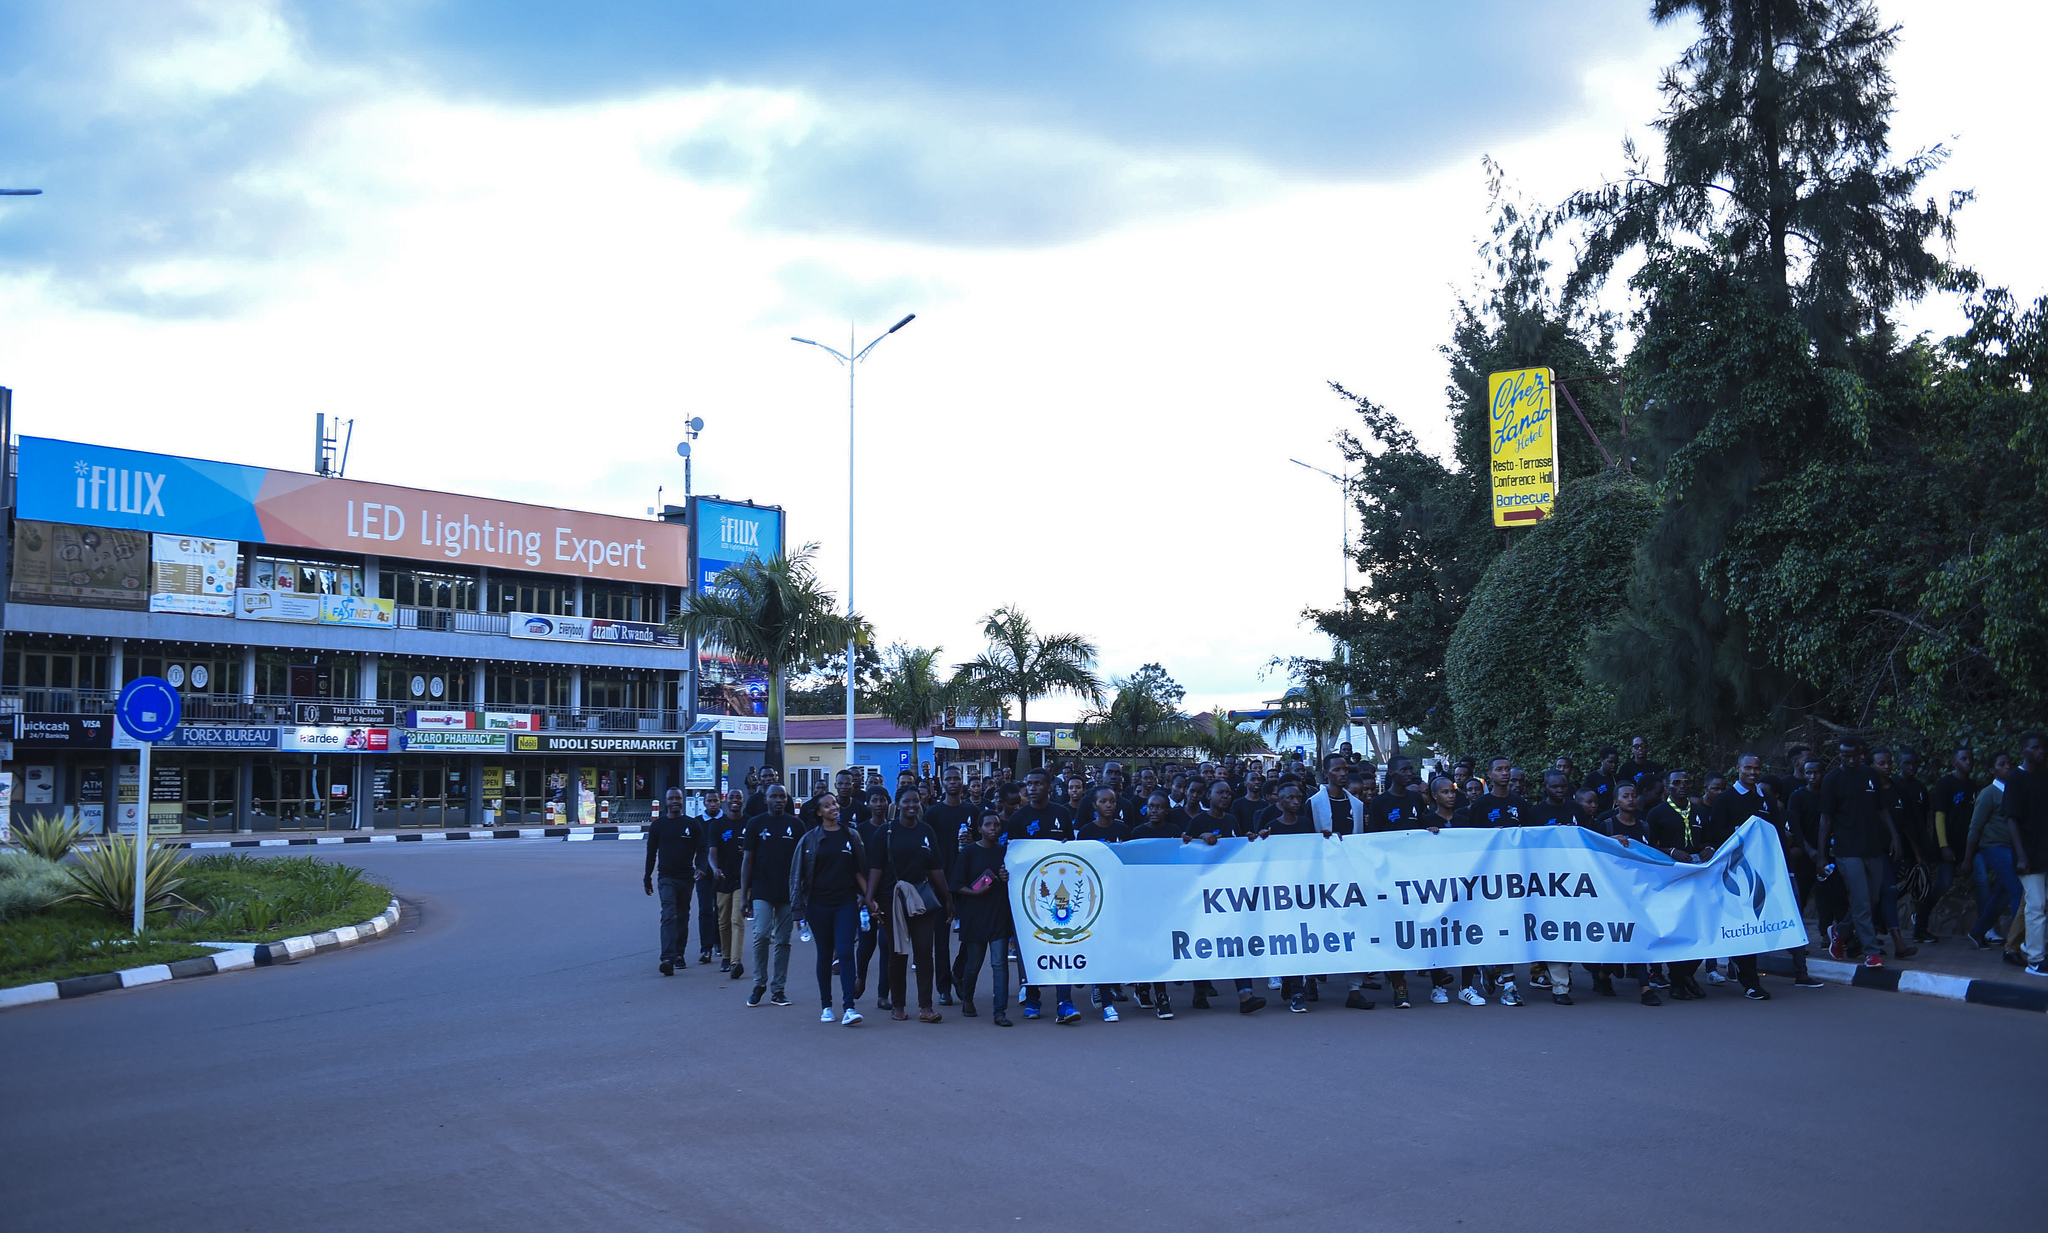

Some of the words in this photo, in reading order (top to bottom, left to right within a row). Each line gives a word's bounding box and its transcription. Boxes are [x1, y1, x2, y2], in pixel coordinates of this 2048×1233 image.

[1493, 372, 1548, 420] Chez
[1494, 397, 1550, 454] Lando
[1515, 424, 1544, 453] Hotel
[1493, 460, 1514, 472] Resto
[1519, 457, 1552, 470] Terrasse
[1494, 474, 1535, 488] Conference
[1496, 491, 1550, 507] Barbecue
[347, 500, 405, 541] LED
[422, 510, 541, 566] Lighting
[556, 527, 646, 572] Expert
[559, 622, 584, 639] Everybody
[621, 626, 654, 641] Rwanda
[332, 707, 347, 715] THE
[348, 707, 385, 715] JUNCTION
[23, 721, 70, 731] uickcash
[82, 720, 101, 728] VISA
[490, 718, 508, 728] Pizza
[183, 729, 222, 741] FOREX
[225, 730, 271, 742] BUREAU
[417, 733, 440, 743] KARO
[444, 734, 492, 744] PHARMACY
[519, 736, 537, 748] Ndoli
[550, 738, 589, 750] NDOLI
[591, 738, 678, 750] SUPERMARKET
[82, 781, 103, 789] ATM
[83, 809, 102, 817] VISA
[1202, 882, 1367, 914] KWIBUKA
[1395, 872, 1598, 906] TWIYUBAKA
[1171, 922, 1355, 960] Remember
[1395, 916, 1484, 950] Unite
[1523, 913, 1636, 943] Renew
[1720, 918, 1797, 941] kwibuka24
[1037, 954, 1087, 970] CNLG
